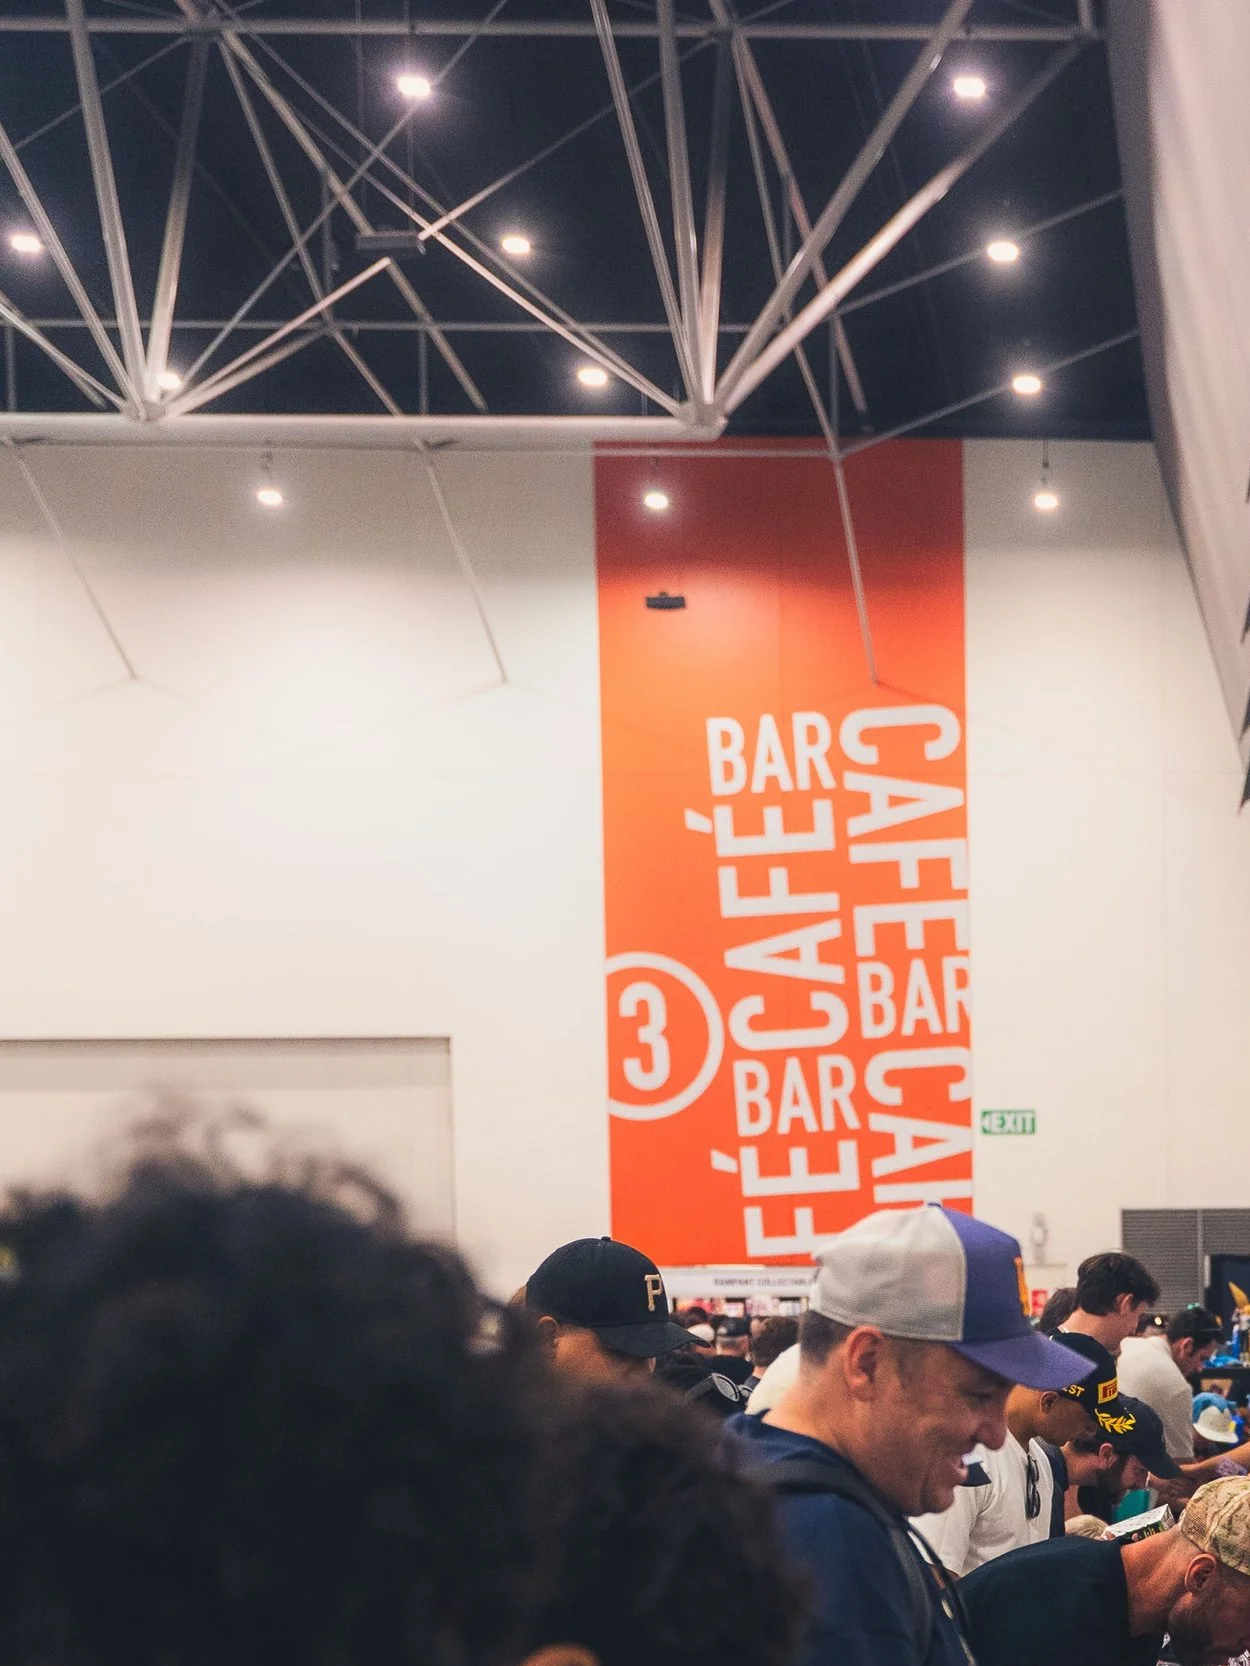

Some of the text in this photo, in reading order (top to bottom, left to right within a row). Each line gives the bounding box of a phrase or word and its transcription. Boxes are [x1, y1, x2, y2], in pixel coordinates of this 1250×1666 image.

[706, 711, 836, 796] BAR
[684, 799, 849, 1053] CAFÉ
[619, 981, 671, 1091] 3
[857, 956, 971, 1039] BAR
[732, 1056, 861, 1137] BAR
[990, 1111, 1035, 1134] EXIT
[644, 1273, 663, 1312] P
